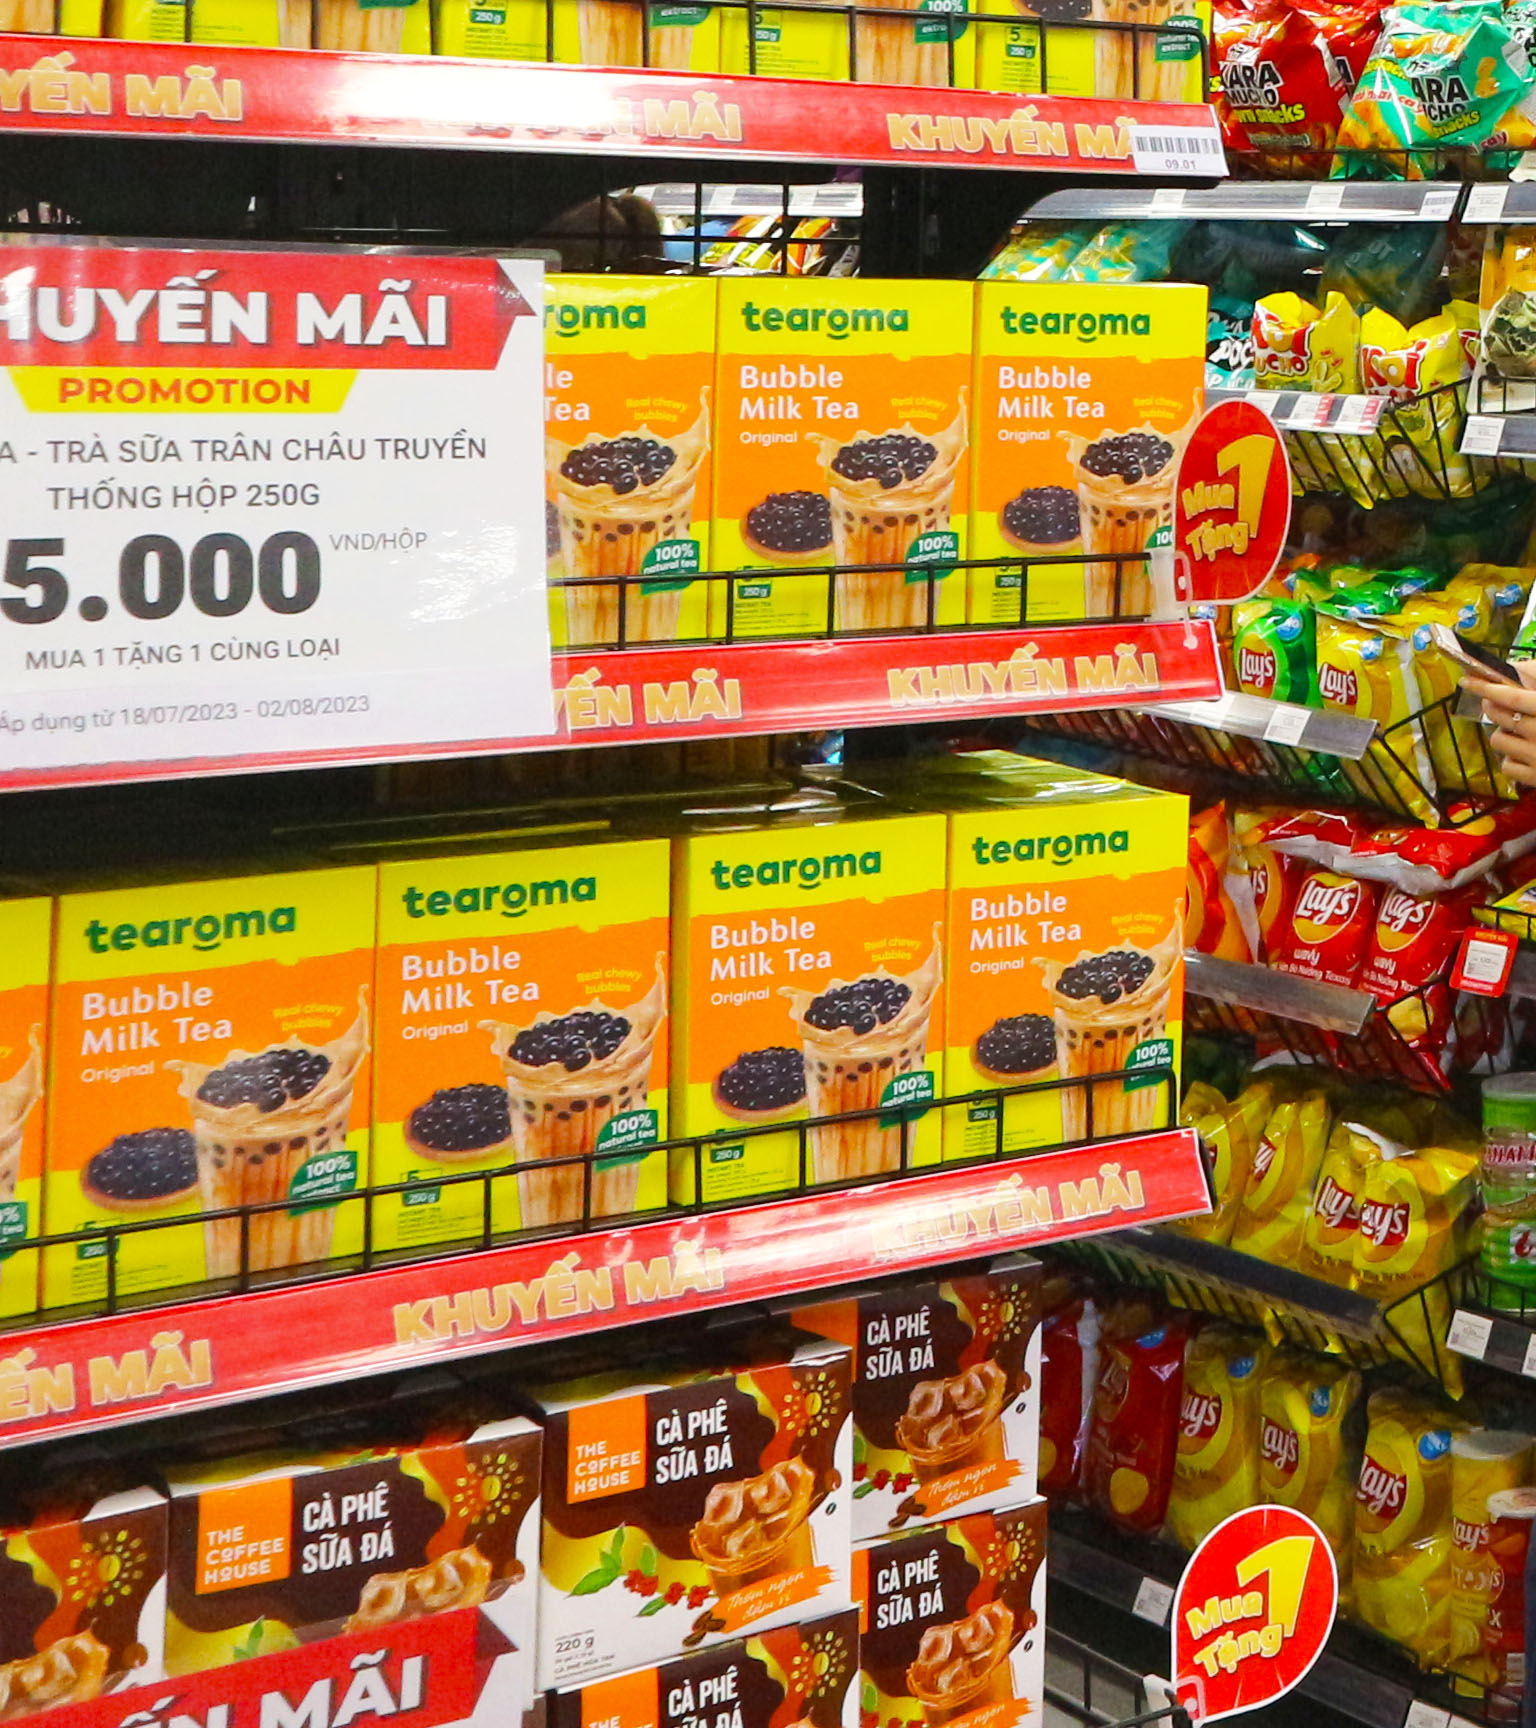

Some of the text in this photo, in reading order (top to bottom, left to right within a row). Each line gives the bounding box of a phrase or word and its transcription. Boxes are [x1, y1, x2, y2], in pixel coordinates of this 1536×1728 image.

[886, 103, 1136, 160] KHUYẾN MÃ
[1165, 158, 1197, 170] 09.01
[0, 267, 446, 346] HUYẾN MÃI
[741, 301, 910, 339] tearoma
[58, 377, 311, 404] PROMOTION
[46, 430, 108, 464] TRÀ
[119, 434, 181, 462] SỮA
[193, 435, 271, 462] TRÂN
[282, 431, 366, 461] CHÂU
[375, 428, 487, 460] TRUYỀN
[46, 478, 320, 513] THỐNG HỘP 250G
[0, 530, 428, 625] 5.000 VND/HỘP
[25, 637, 340, 670] MUA 1 TẶNG 1 CÙNG LOẠI
[1239, 647, 1276, 688] Lay's
[32, 711, 86, 733] dụng
[92, 709, 115, 728] từ
[122, 702, 237, 726] 18/07/2023
[257, 695, 370, 720] 02/08/2023
[85, 905, 297, 953] tearoma
[303, 1481, 389, 1533] CÀ PHÊ
[206, 1537, 284, 1565] COFFEE
[207, 1527, 244, 1544] THE
[303, 1520, 395, 1575] SỮA ĐÁ
[204, 1561, 271, 1585] HOUSE
[1236, 1535, 1316, 1637] 1
[1186, 1591, 1262, 1640] Mua
[555, 1638, 595, 1653] 220 g
[1194, 1621, 1284, 1677] Tặng
